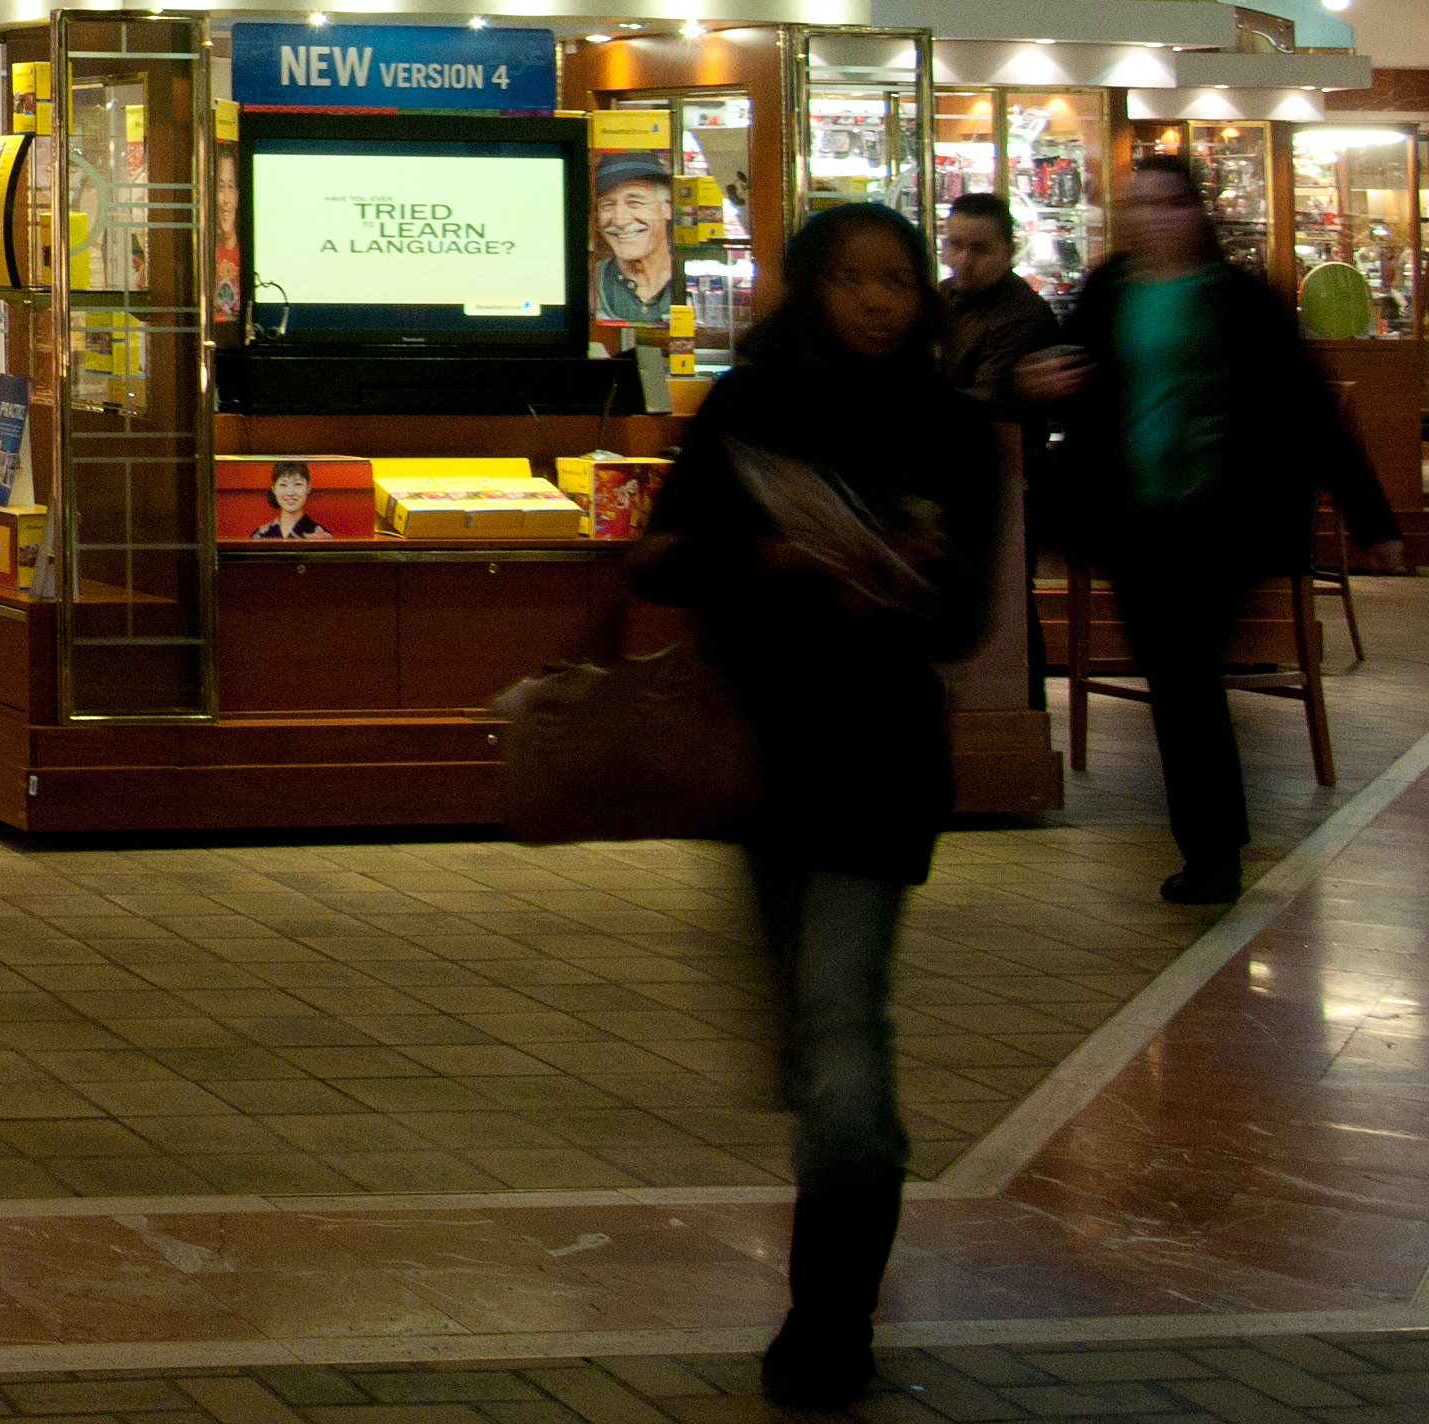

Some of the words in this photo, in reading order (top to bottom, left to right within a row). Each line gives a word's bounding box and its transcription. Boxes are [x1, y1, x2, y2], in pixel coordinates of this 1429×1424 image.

[280, 45, 373, 88] NEW
[379, 63, 484, 89] VERSION
[491, 65, 511, 90] 4
[354, 202, 453, 221] TRIED
[379, 222, 486, 239] LEARN
[320, 239, 339, 253] A
[349, 239, 516, 255] LANGUAGE?
